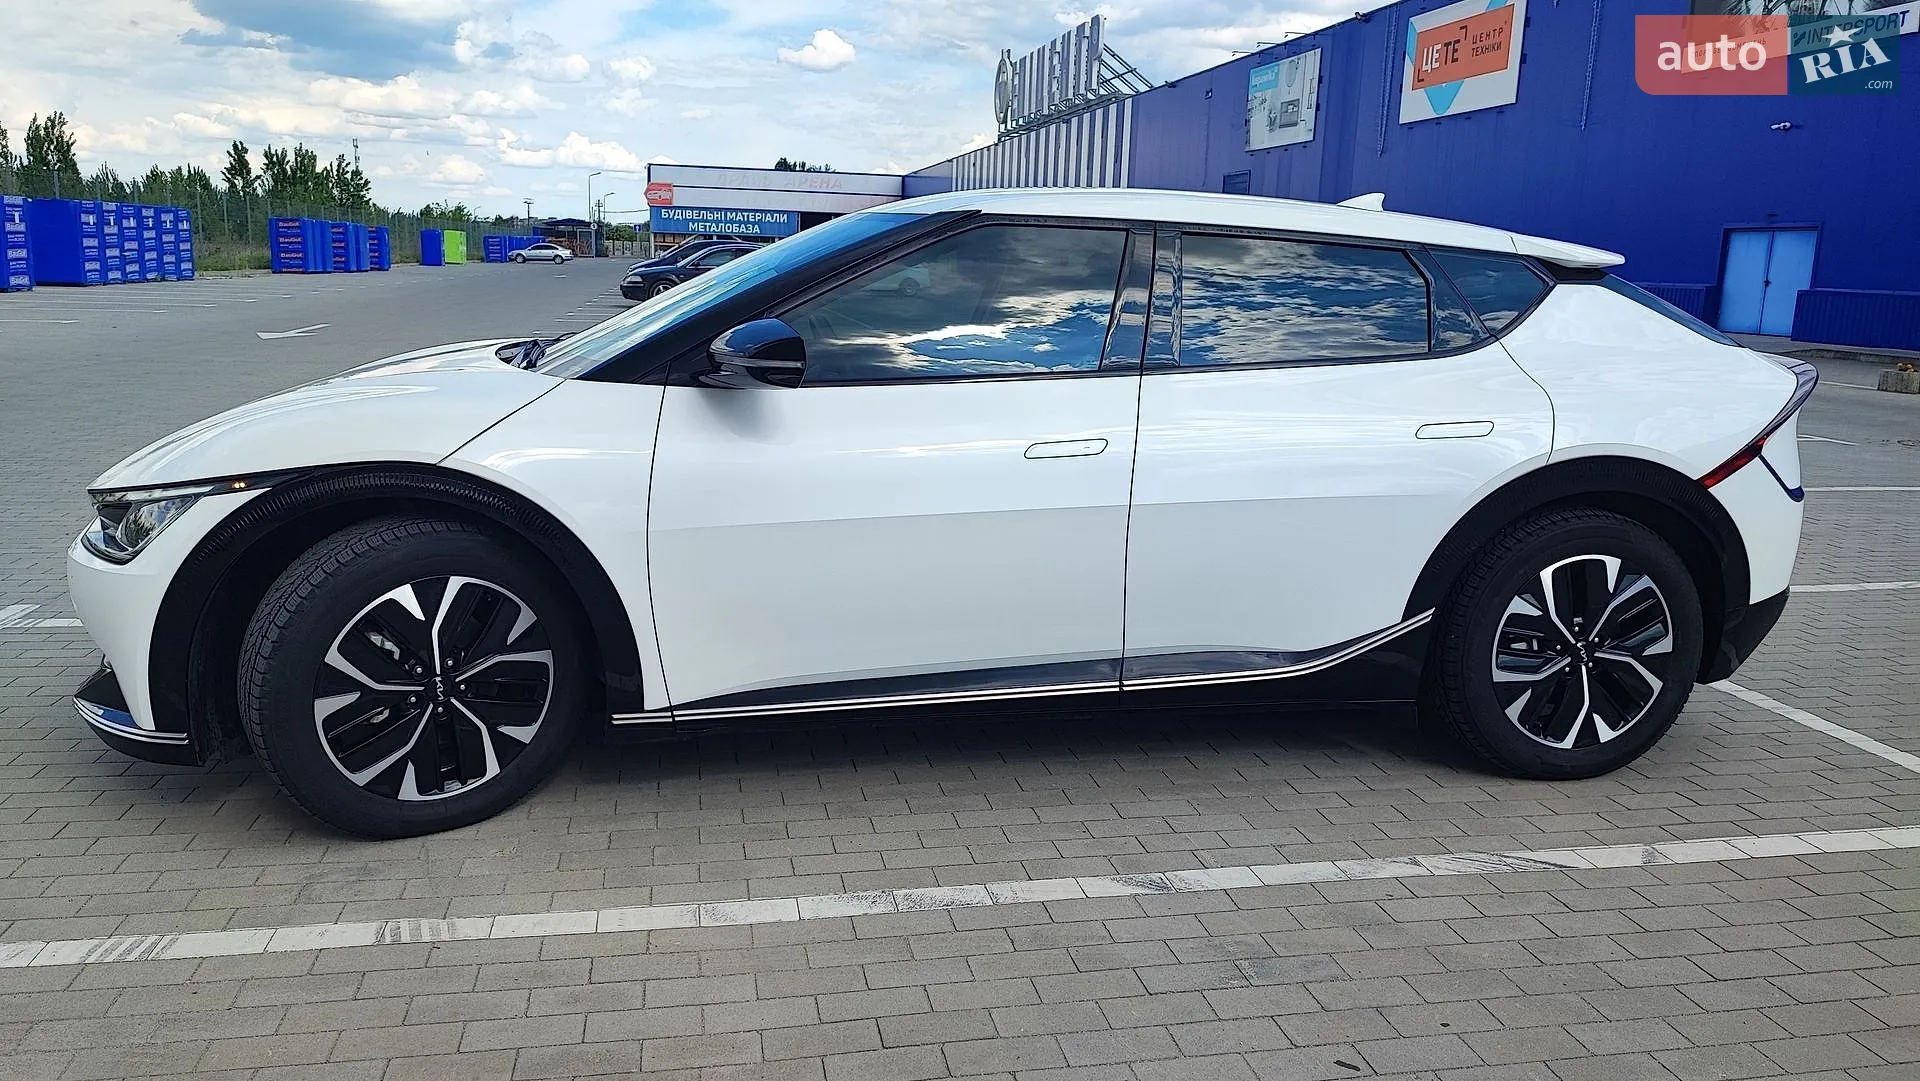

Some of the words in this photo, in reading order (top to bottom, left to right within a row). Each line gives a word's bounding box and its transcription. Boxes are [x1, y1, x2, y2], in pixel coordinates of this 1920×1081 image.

[1472, 27, 1504, 44] ЦЕНТР
[1471, 41, 1502, 57] ТЕХНІКИ
[661, 209, 725, 221] БУДІВЕЛЬНІ
[726, 211, 788, 223] МАТЕРІАЛИ
[688, 222, 760, 233] МЕТАЛОБАЗА
